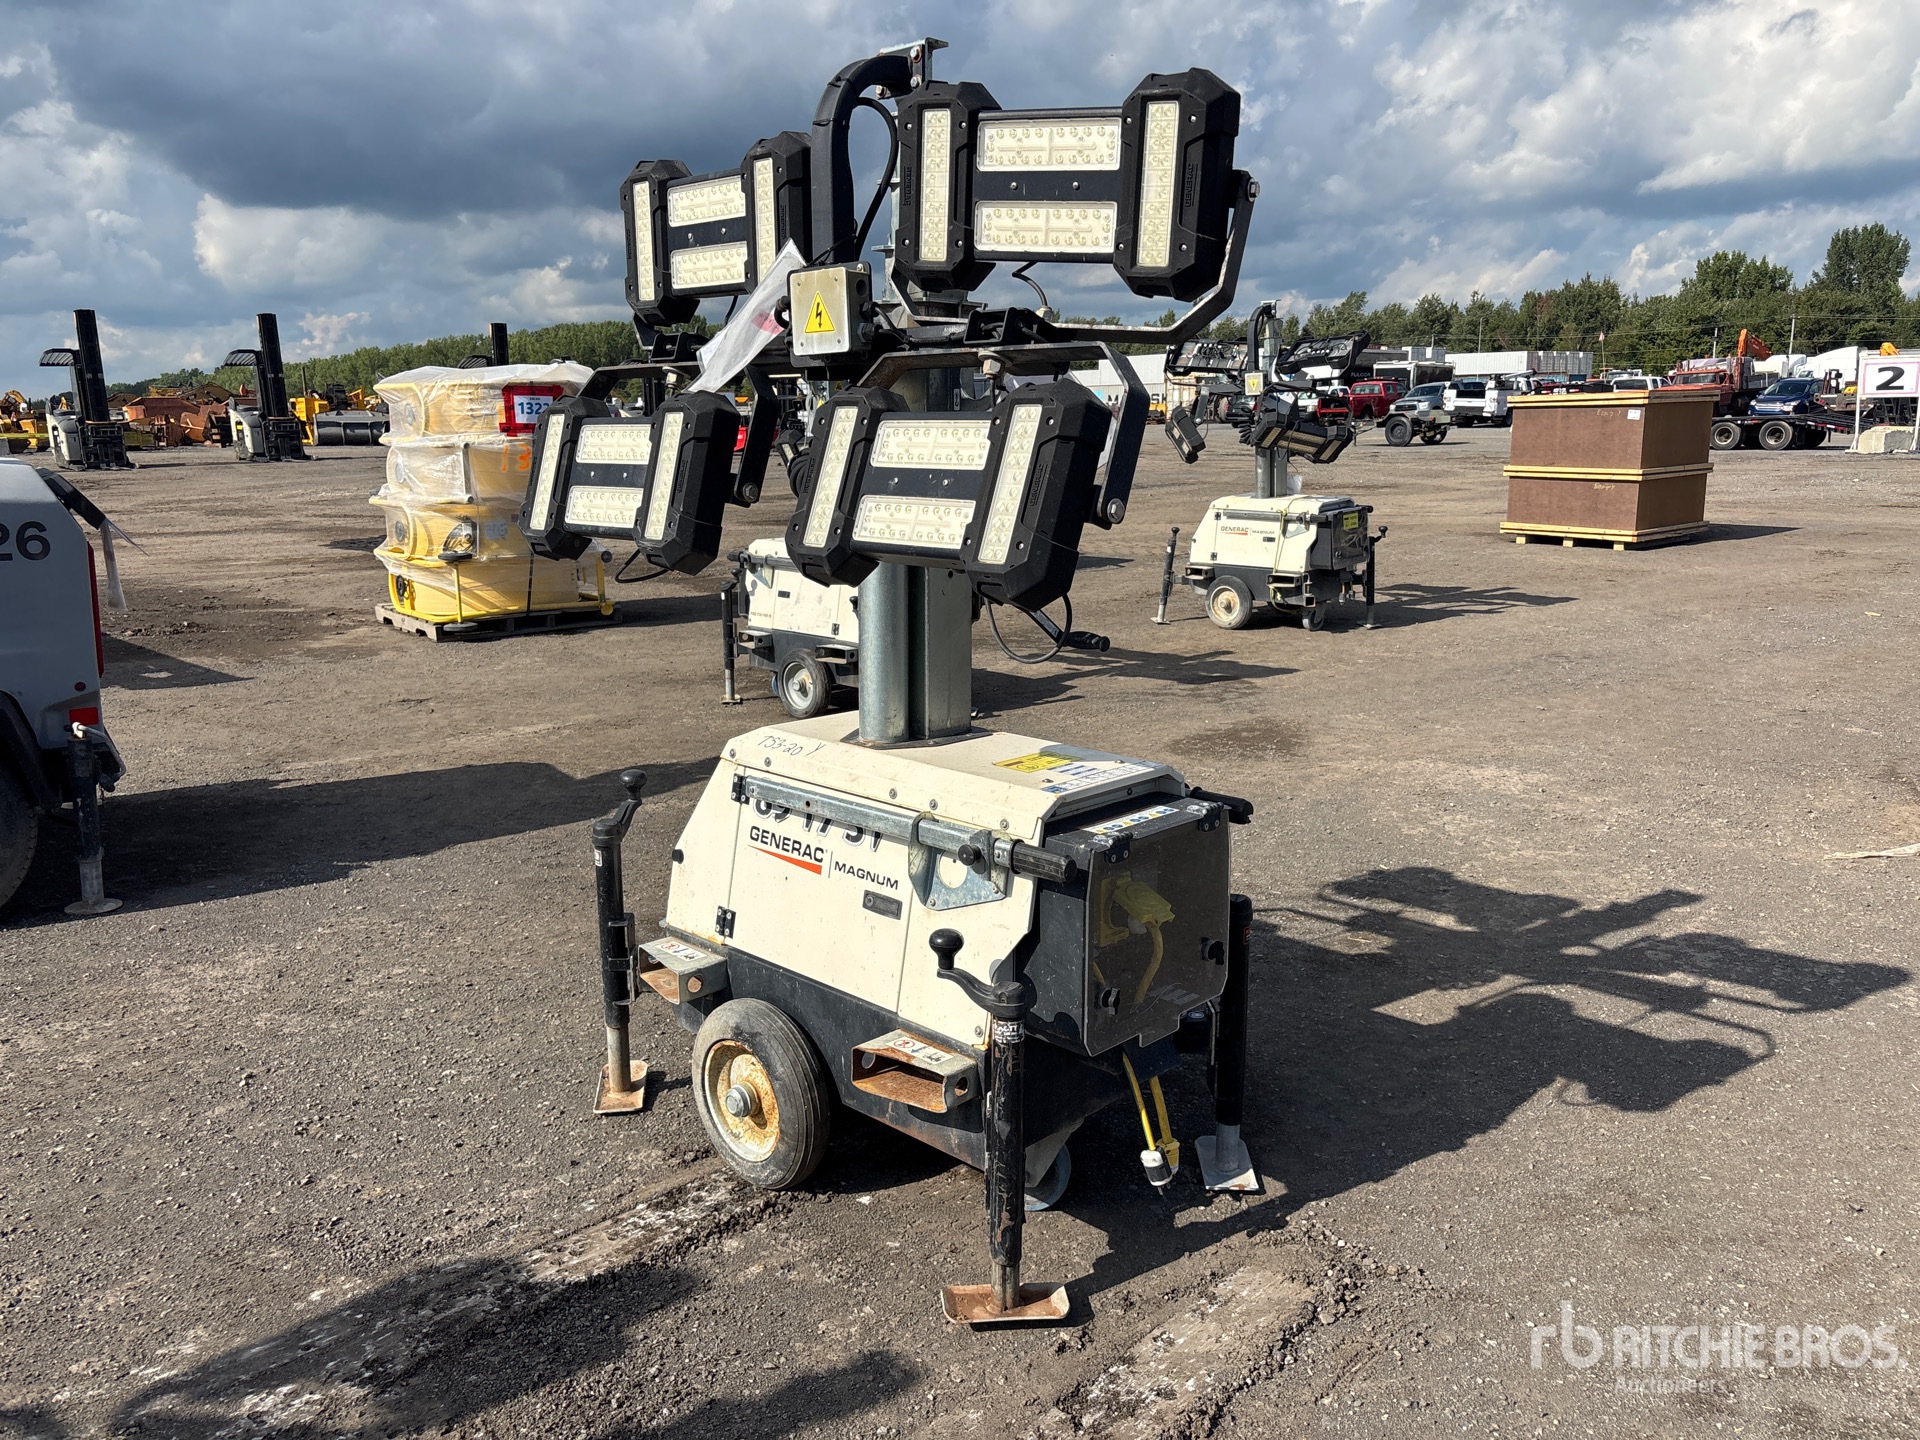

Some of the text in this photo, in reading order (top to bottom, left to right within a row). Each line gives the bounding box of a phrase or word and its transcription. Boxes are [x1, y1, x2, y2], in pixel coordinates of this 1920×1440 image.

[1875, 366, 1905, 391] 2
[1220, 525, 1249, 533] GENERAC
[749, 825, 824, 863] GENERAC
[834, 860, 899, 890] MAGNUM
